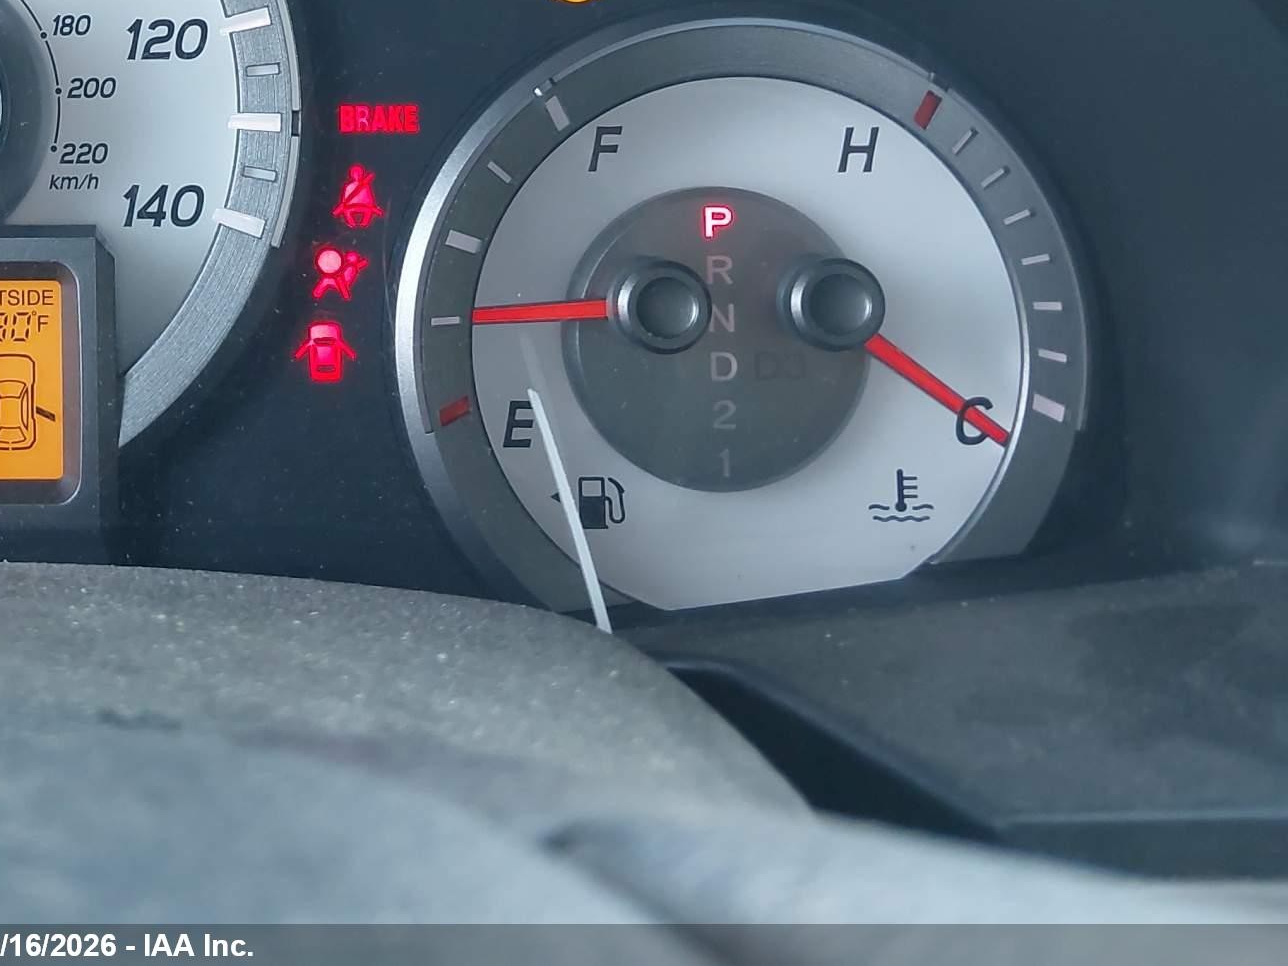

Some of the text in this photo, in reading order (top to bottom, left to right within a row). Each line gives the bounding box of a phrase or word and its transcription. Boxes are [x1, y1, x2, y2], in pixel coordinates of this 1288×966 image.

[52, 14, 91, 36] 180
[126, 18, 208, 61] 120
[67, 77, 116, 99] 200
[339, 104, 420, 134] BRAKE
[60, 143, 109, 165] 220
[588, 126, 623, 172] F
[838, 127, 880, 173] H
[48, 171, 100, 192] km/h
[122, 184, 205, 227] 140
[703, 205, 733, 238] P
[705, 255, 734, 285] R
[708, 305, 737, 334] N
[711, 352, 739, 381] D
[503, 401, 535, 448] E
[713, 400, 737, 430] 2
[955, 395, 993, 446] C
